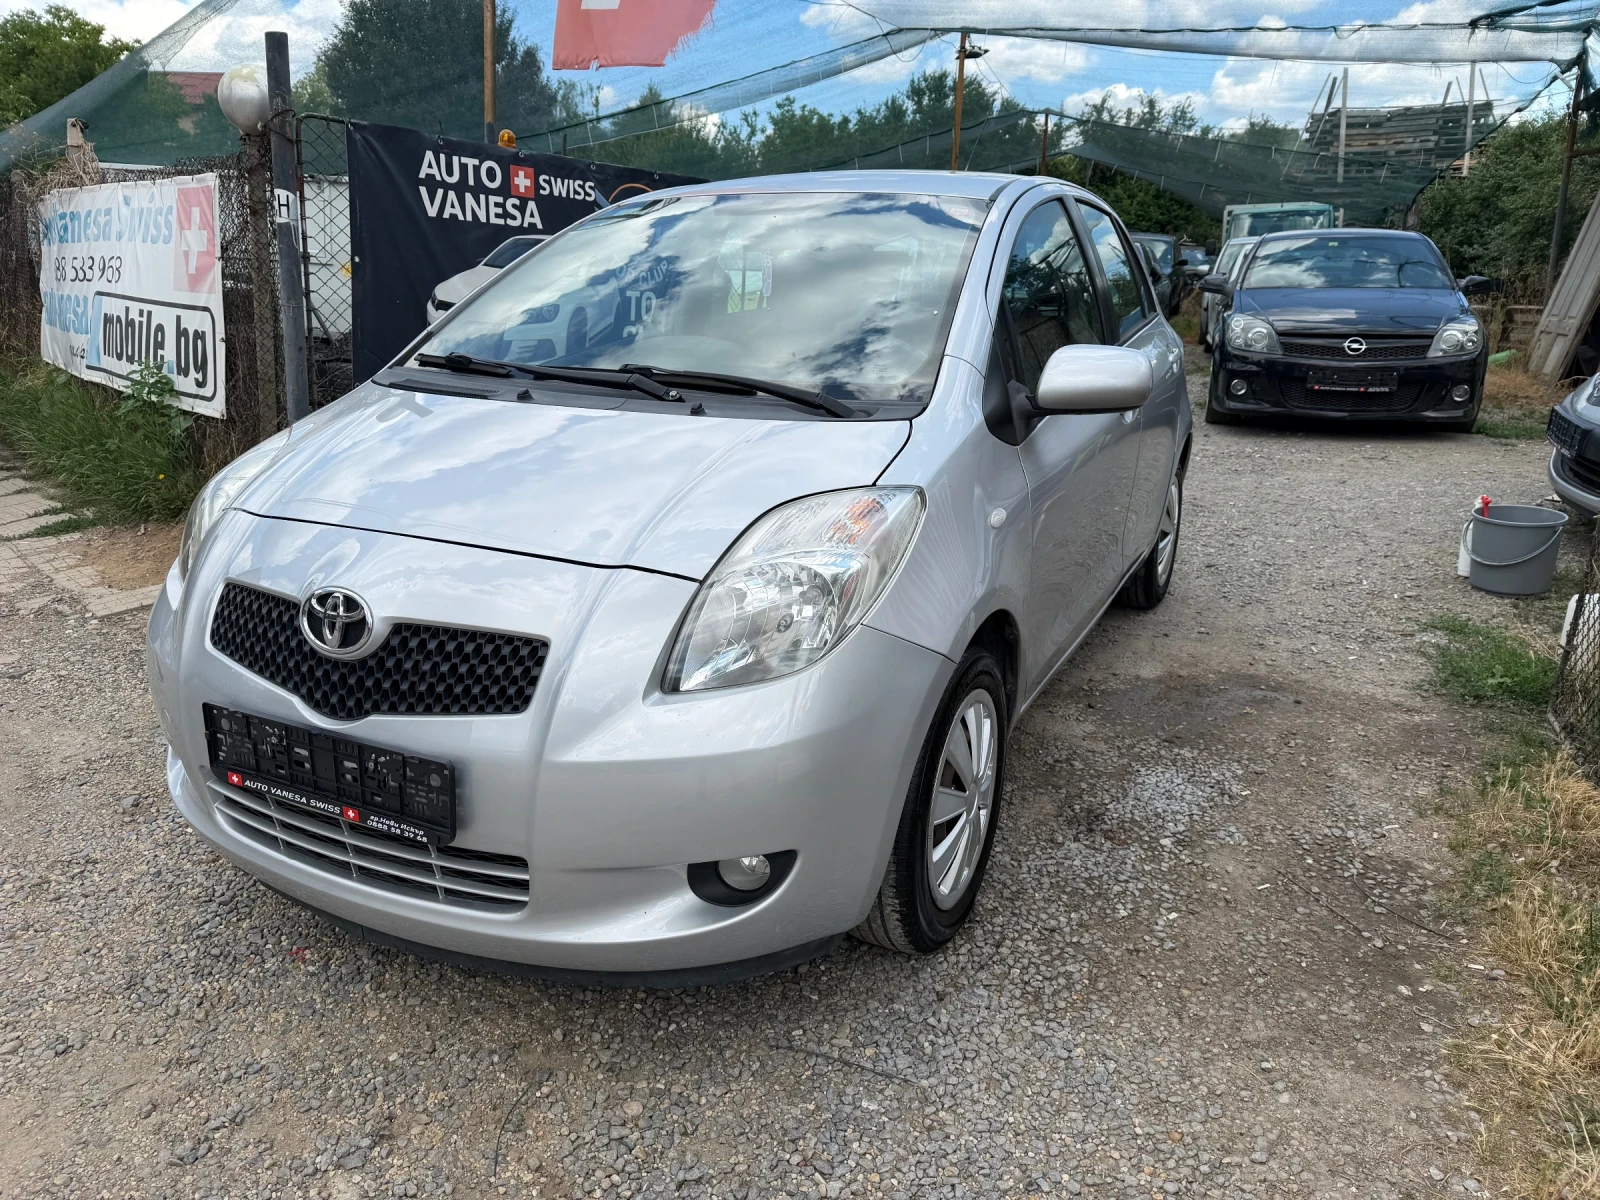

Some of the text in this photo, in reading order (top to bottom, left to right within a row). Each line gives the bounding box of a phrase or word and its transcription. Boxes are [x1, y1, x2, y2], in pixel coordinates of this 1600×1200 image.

[418, 150, 596, 201] AUTO SWISS
[418, 186, 543, 229] VANESA
[103, 306, 208, 389] mobile.bg
[244, 779, 341, 814] AUTO VANESA SWISS
[367, 819, 388, 831] 0888
[403, 830, 415, 838] 39
